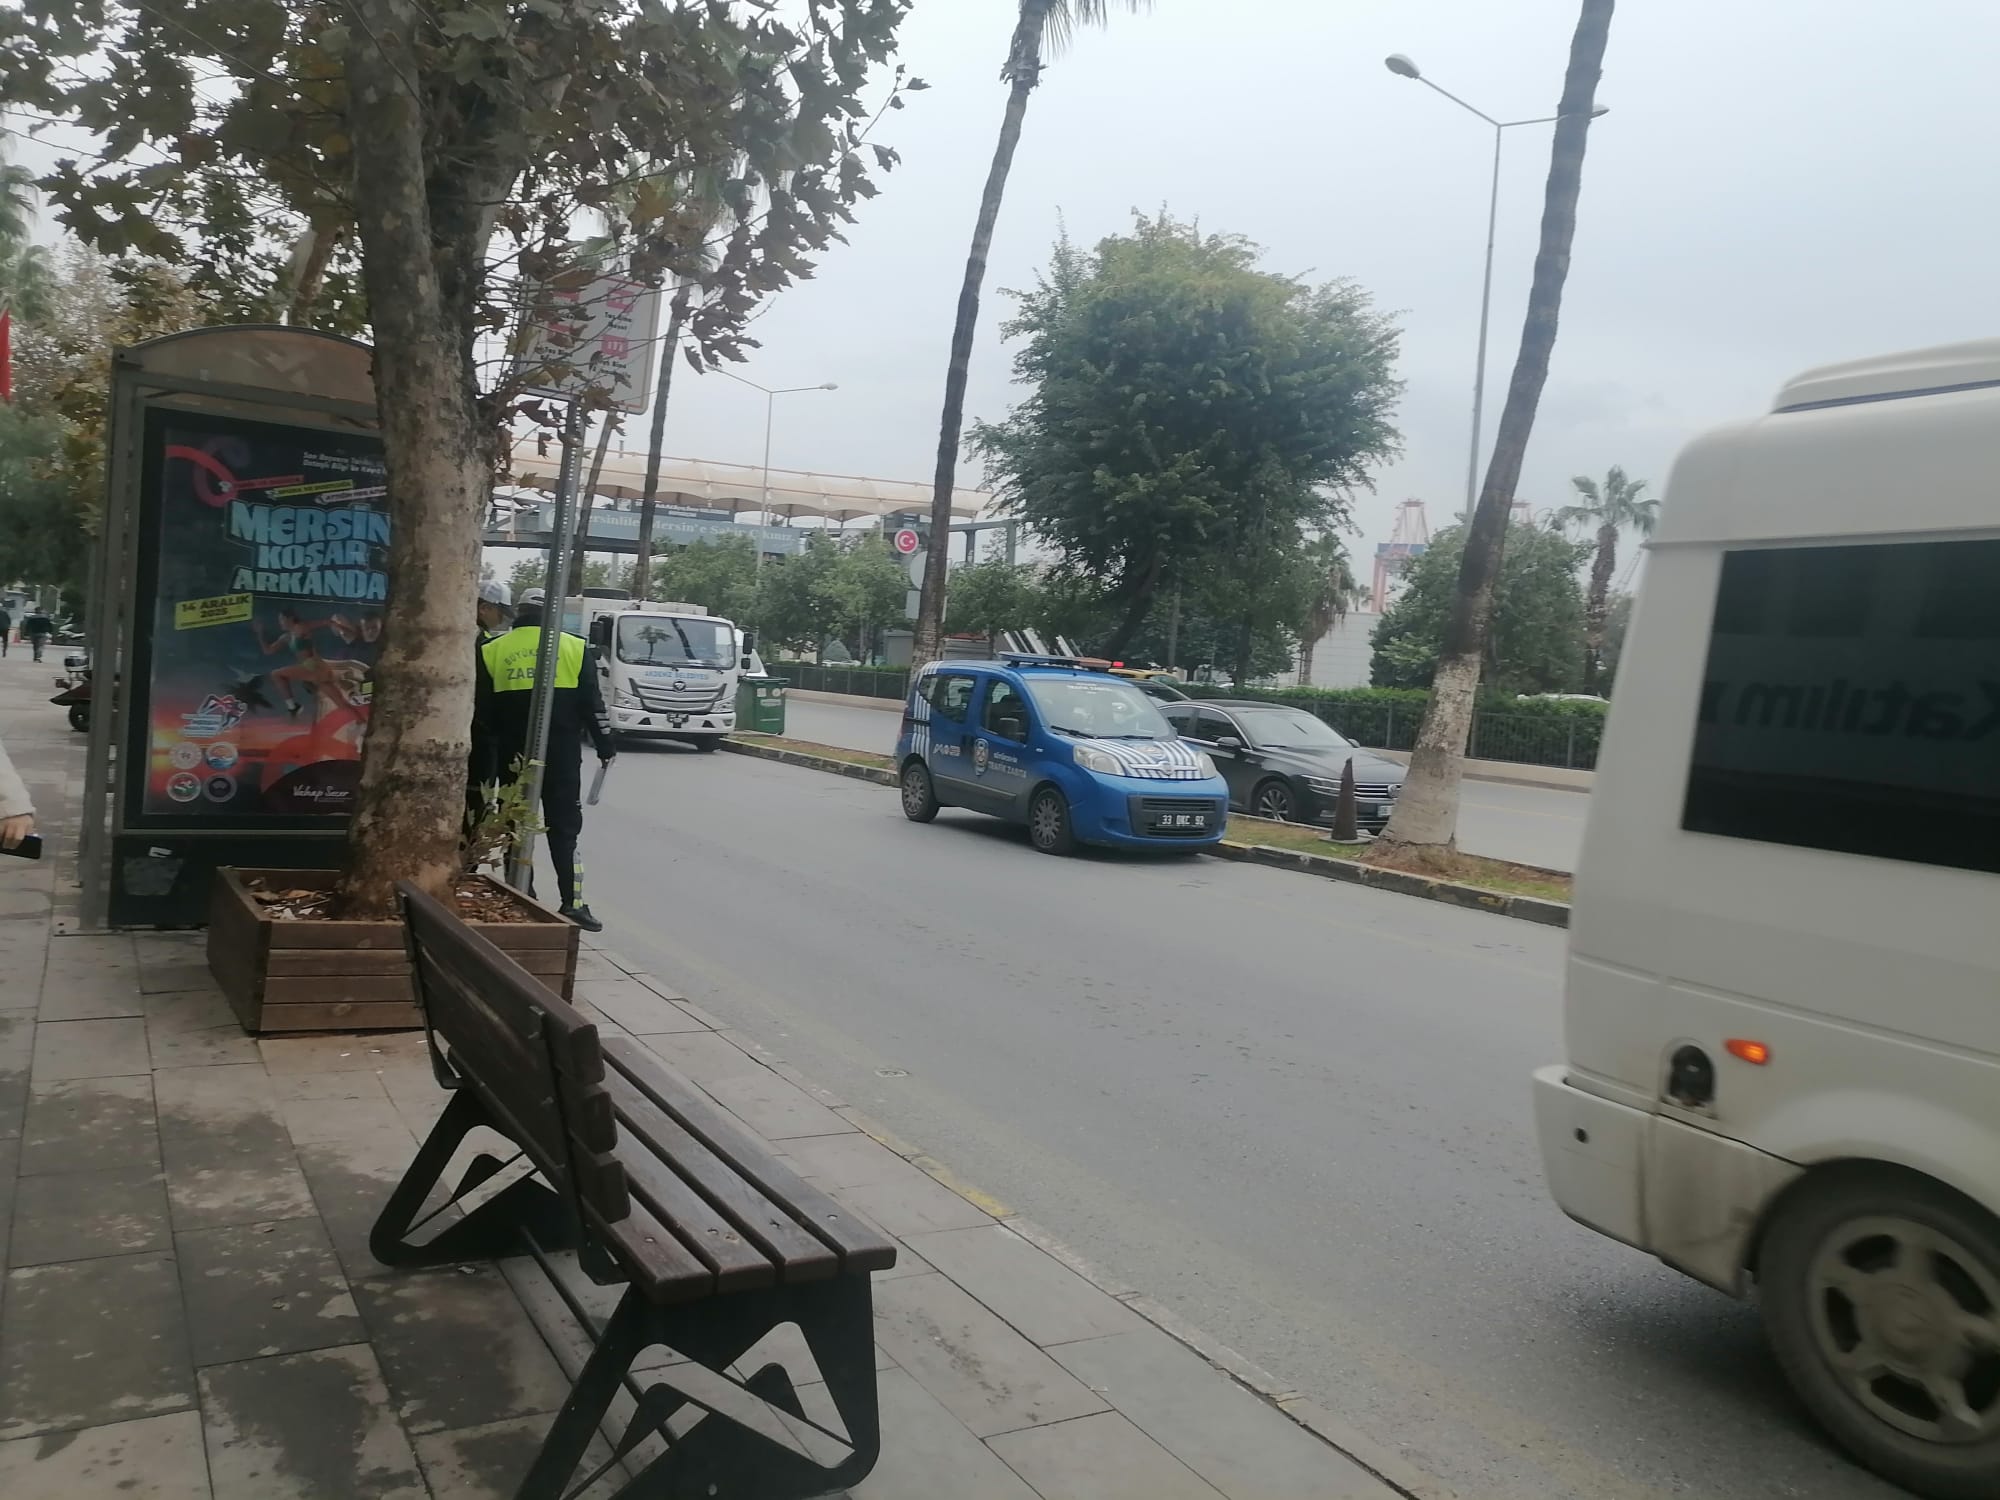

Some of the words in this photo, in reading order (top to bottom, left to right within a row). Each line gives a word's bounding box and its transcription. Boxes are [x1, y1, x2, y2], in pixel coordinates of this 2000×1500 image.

[231, 501, 391, 547] MERSİN
[258, 540, 368, 572] KOŞAR
[1161, 814, 1173, 825] 33
